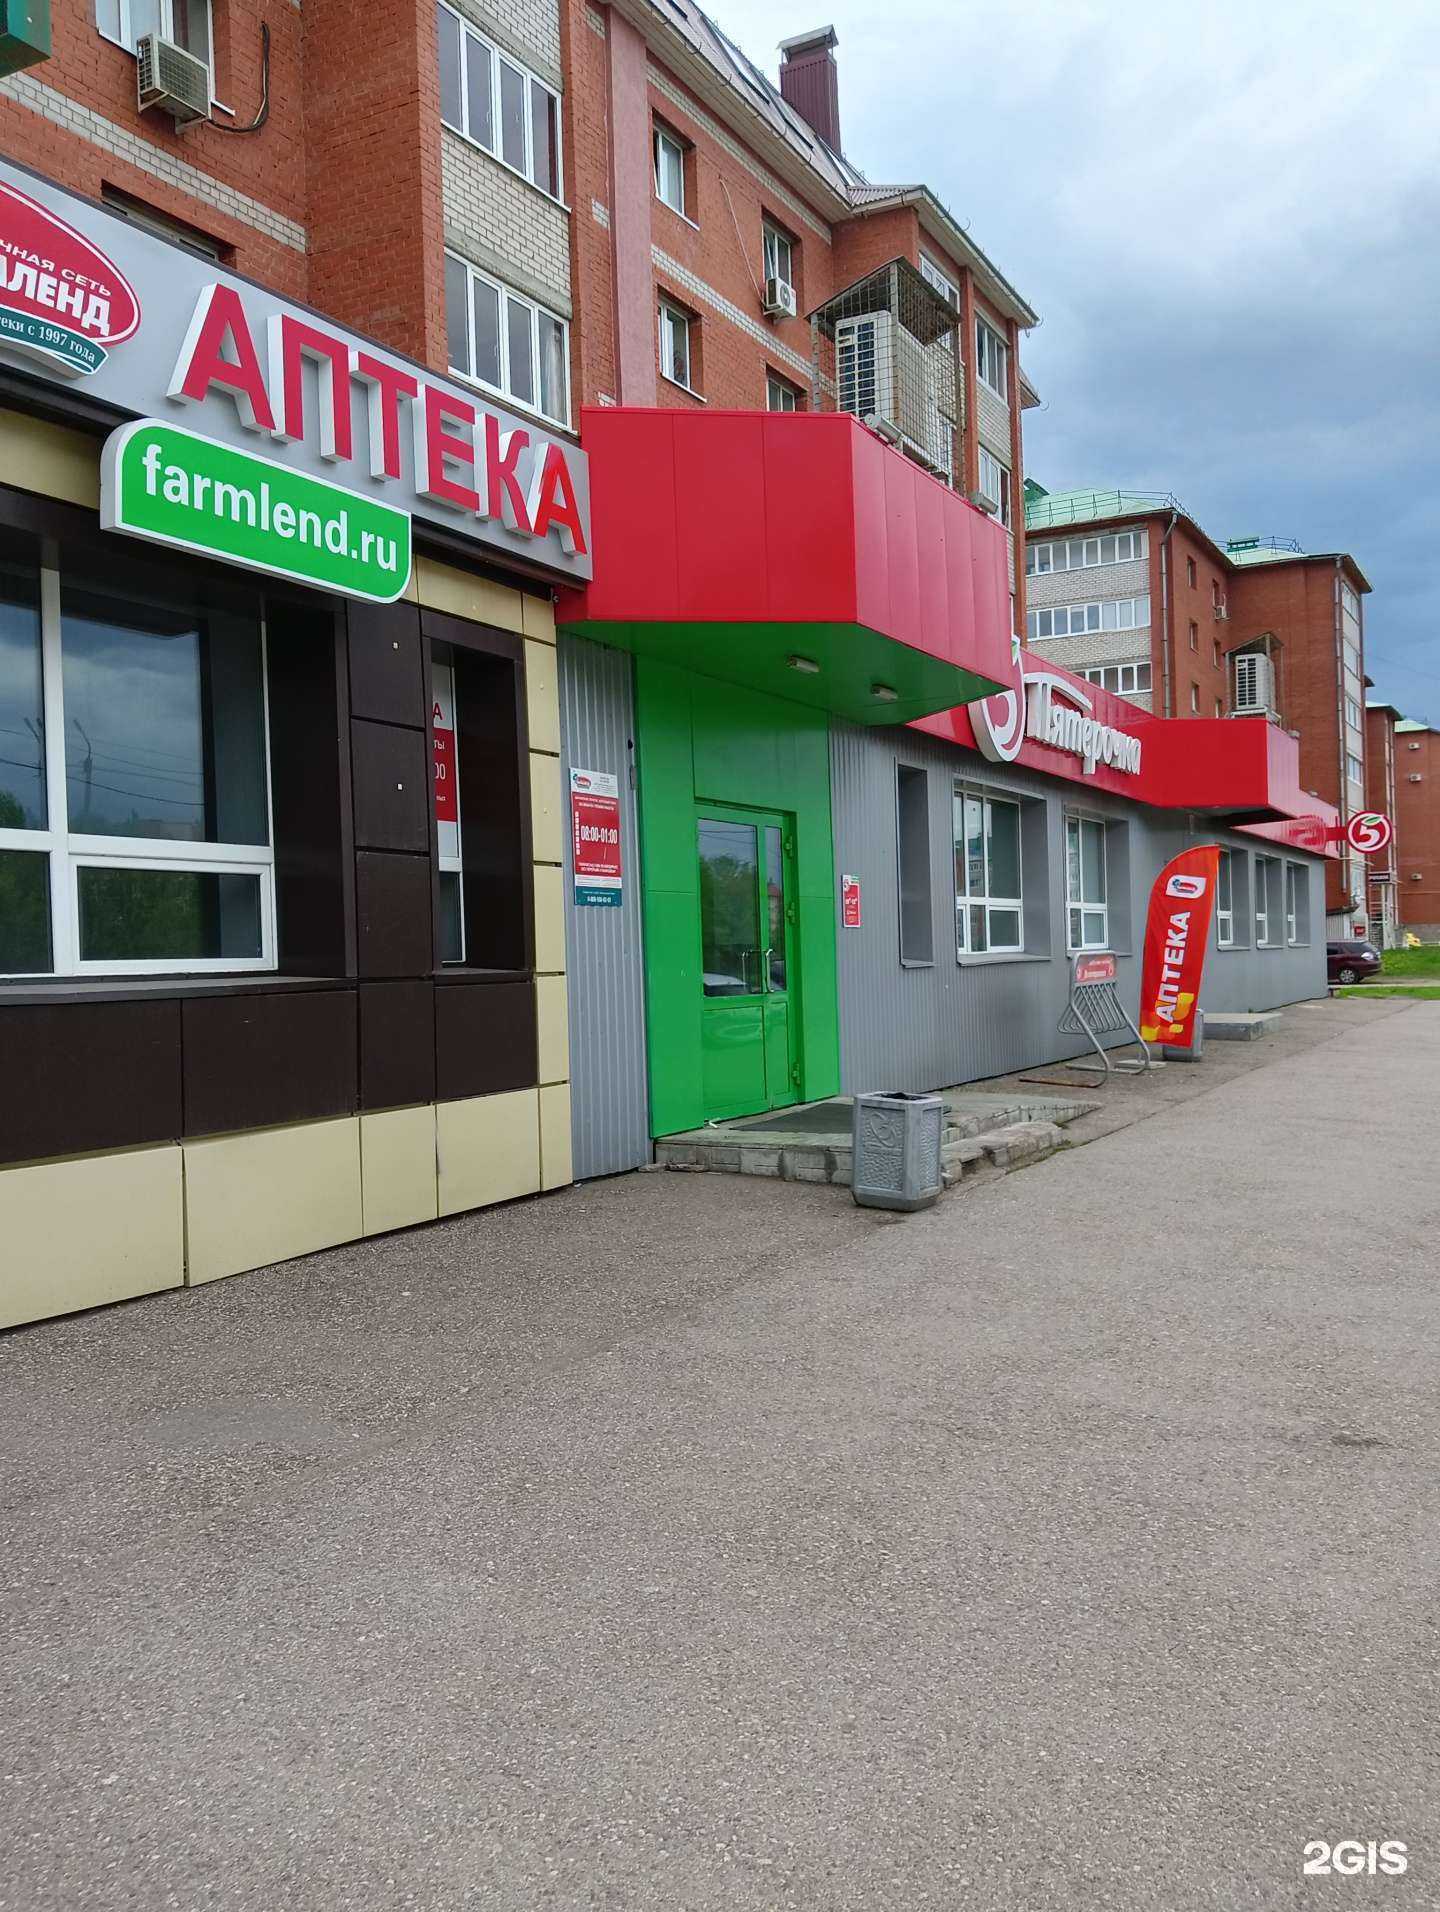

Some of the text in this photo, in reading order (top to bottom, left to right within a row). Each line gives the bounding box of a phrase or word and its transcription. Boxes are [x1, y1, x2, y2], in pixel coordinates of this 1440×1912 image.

[61, 268, 112, 296] СЕТЬ
[28, 324, 36, 336] с
[38, 325, 67, 346] 1997
[69, 339, 96, 363] года
[168, 282, 588, 556] АПТЕКА
[142, 444, 397, 573] farmlend.ru
[1023, 672, 1141, 775] Пятерочка
[1155, 911, 1191, 1024] АПТЕКА
